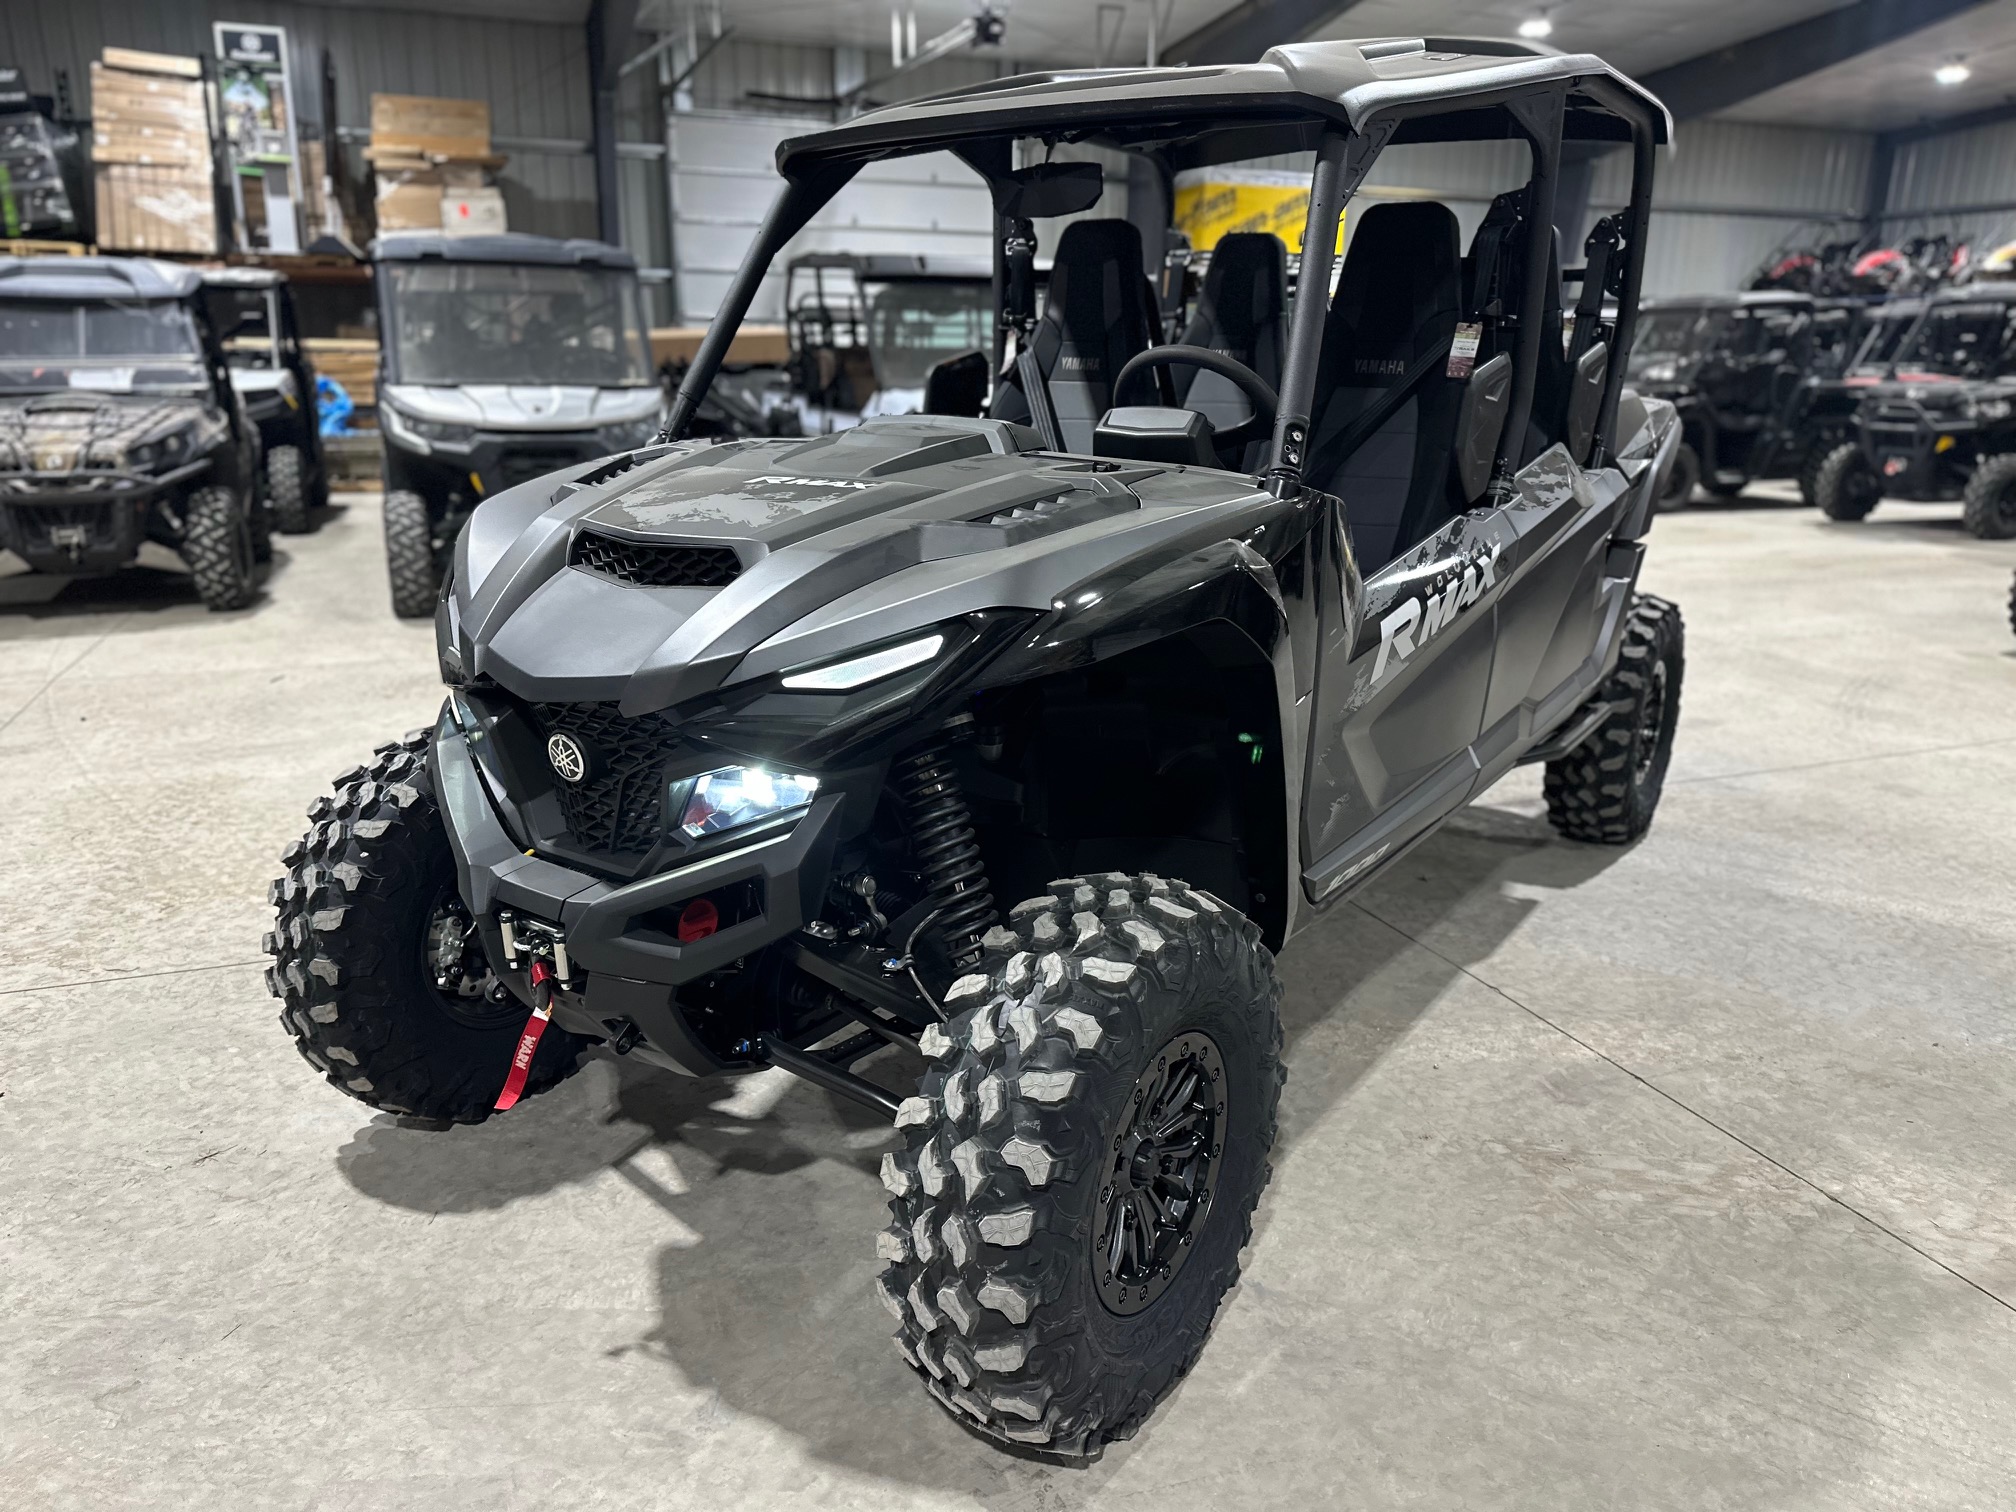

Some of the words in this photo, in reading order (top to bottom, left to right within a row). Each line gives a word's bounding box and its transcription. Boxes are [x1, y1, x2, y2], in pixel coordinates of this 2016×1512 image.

[1061, 356, 1100, 370] YAMAHA
[1354, 359, 1405, 375] YAMAHA
[742, 476, 878, 490] RMAX
[1370, 542, 1501, 685] RMAX
[514, 1034, 537, 1071] WARN
